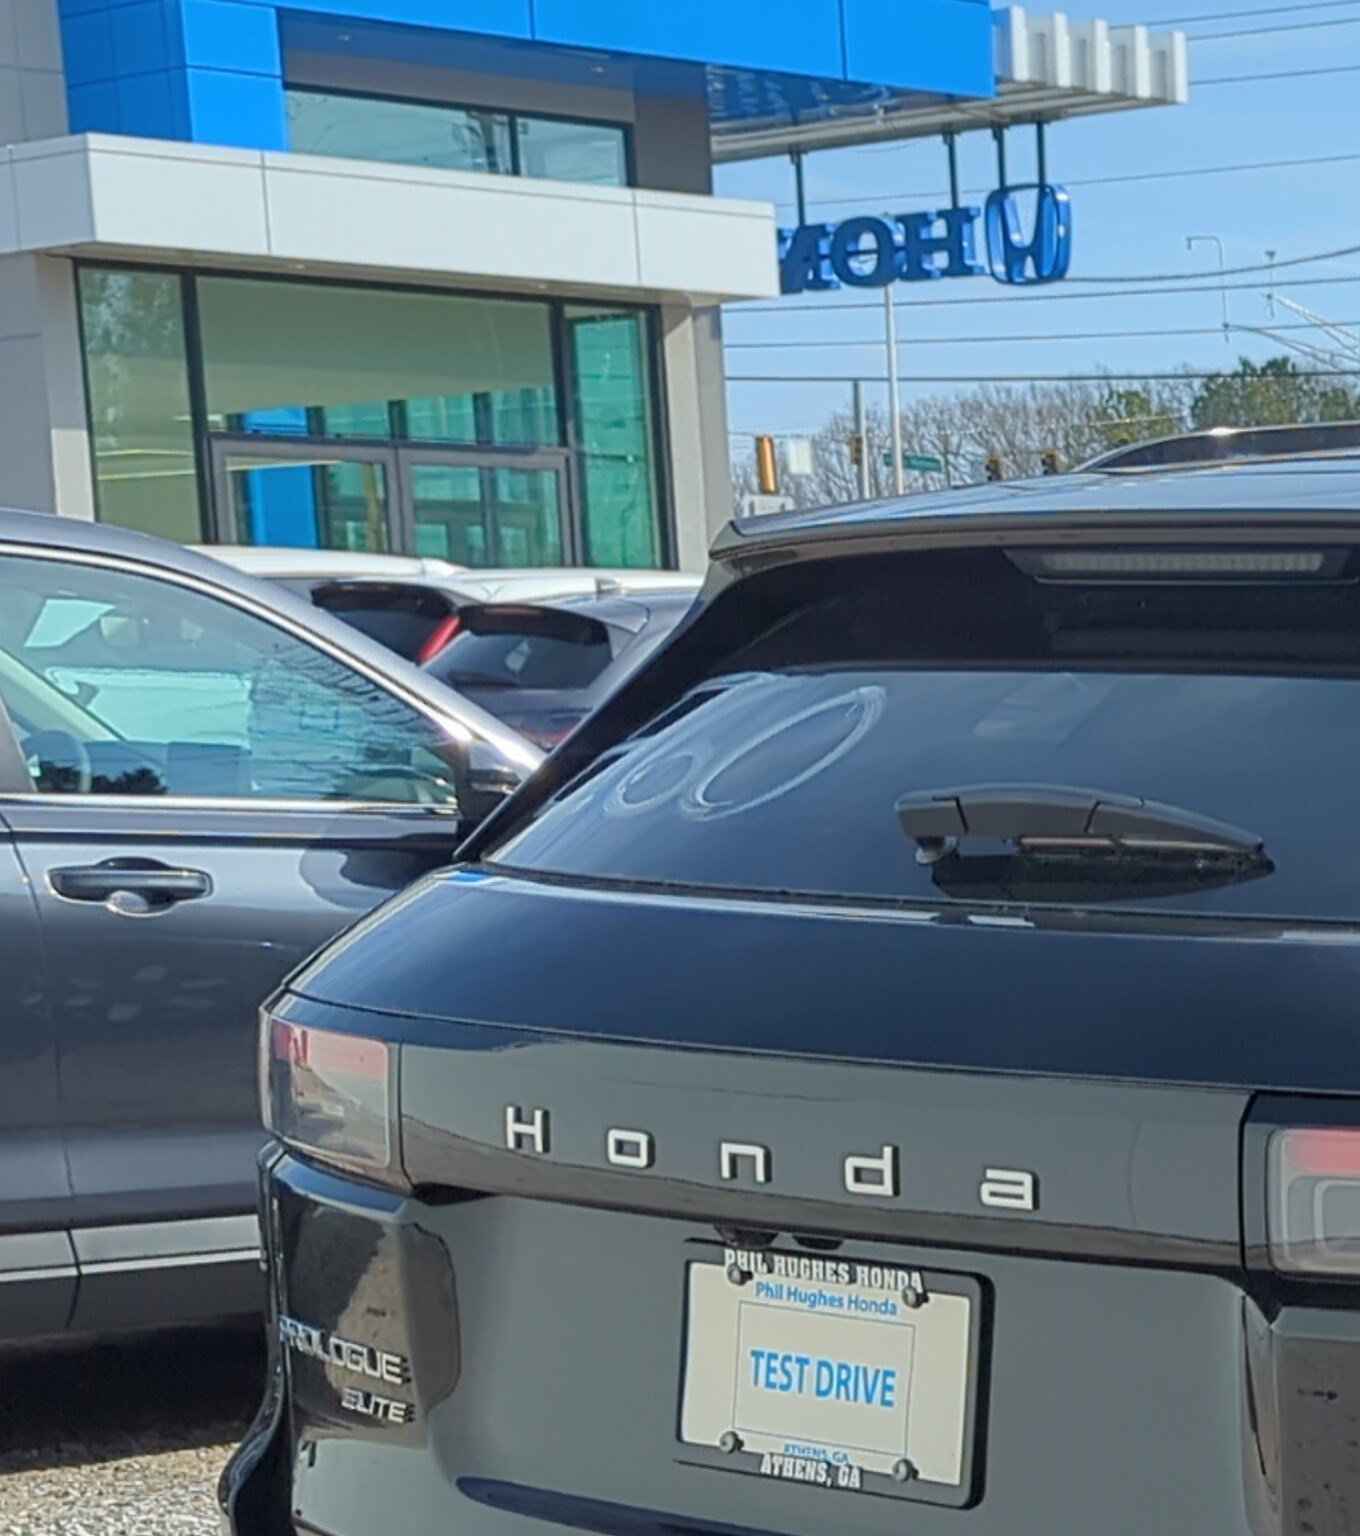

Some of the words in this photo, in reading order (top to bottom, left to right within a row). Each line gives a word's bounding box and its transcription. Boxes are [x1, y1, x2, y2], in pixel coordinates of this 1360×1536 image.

[505, 1105, 1039, 1211] Honda
[725, 1249, 768, 1275] PHIL
[773, 1255, 850, 1284] HUGHES
[856, 1265, 923, 1293] HONDA
[756, 1281, 784, 1300] Phil
[788, 1287, 844, 1310] Hughes
[849, 1297, 898, 1316] Honda
[751, 1348, 810, 1394] TEST
[815, 1361, 895, 1408] DRIVE
[341, 1387, 407, 1423] ELITE
[760, 1453, 833, 1488] ATHENS,
[837, 1464, 862, 1489] GA
